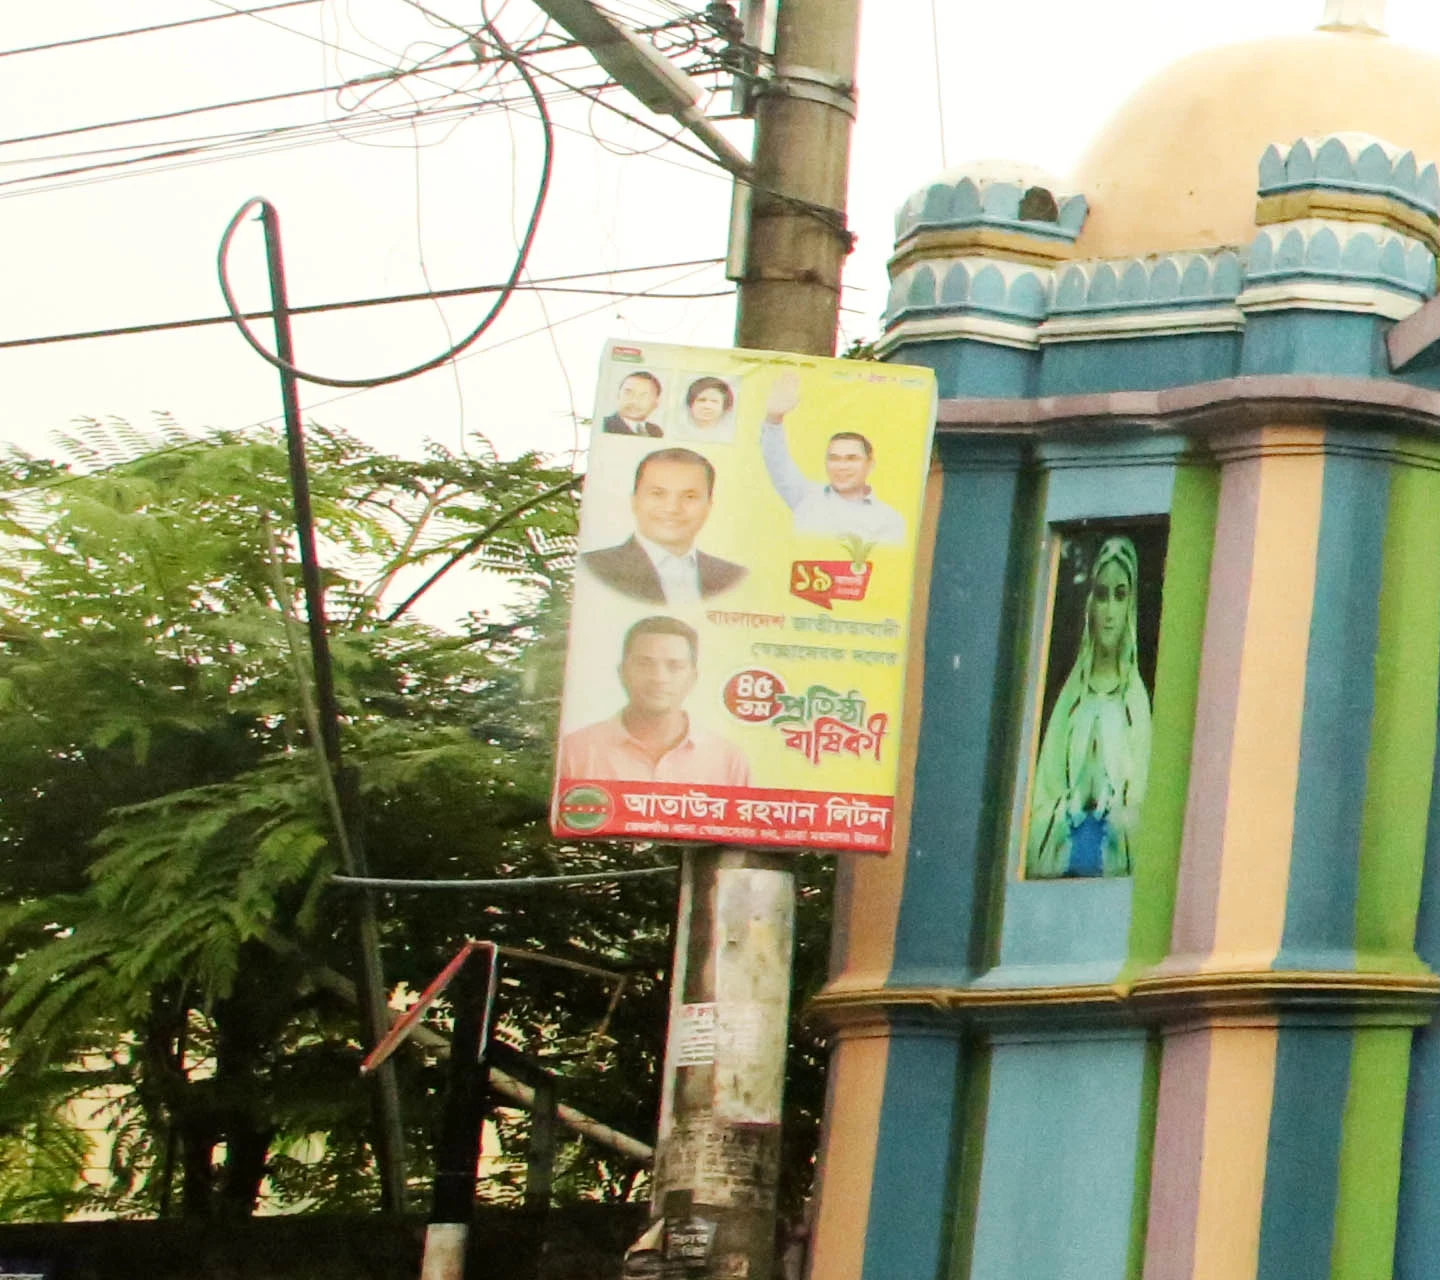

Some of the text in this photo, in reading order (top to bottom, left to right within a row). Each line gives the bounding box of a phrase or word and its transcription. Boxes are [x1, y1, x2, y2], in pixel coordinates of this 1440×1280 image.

[737, 675, 774, 698] ৪৫
[623, 790, 890, 829] আতাউর রহমান লিটন
